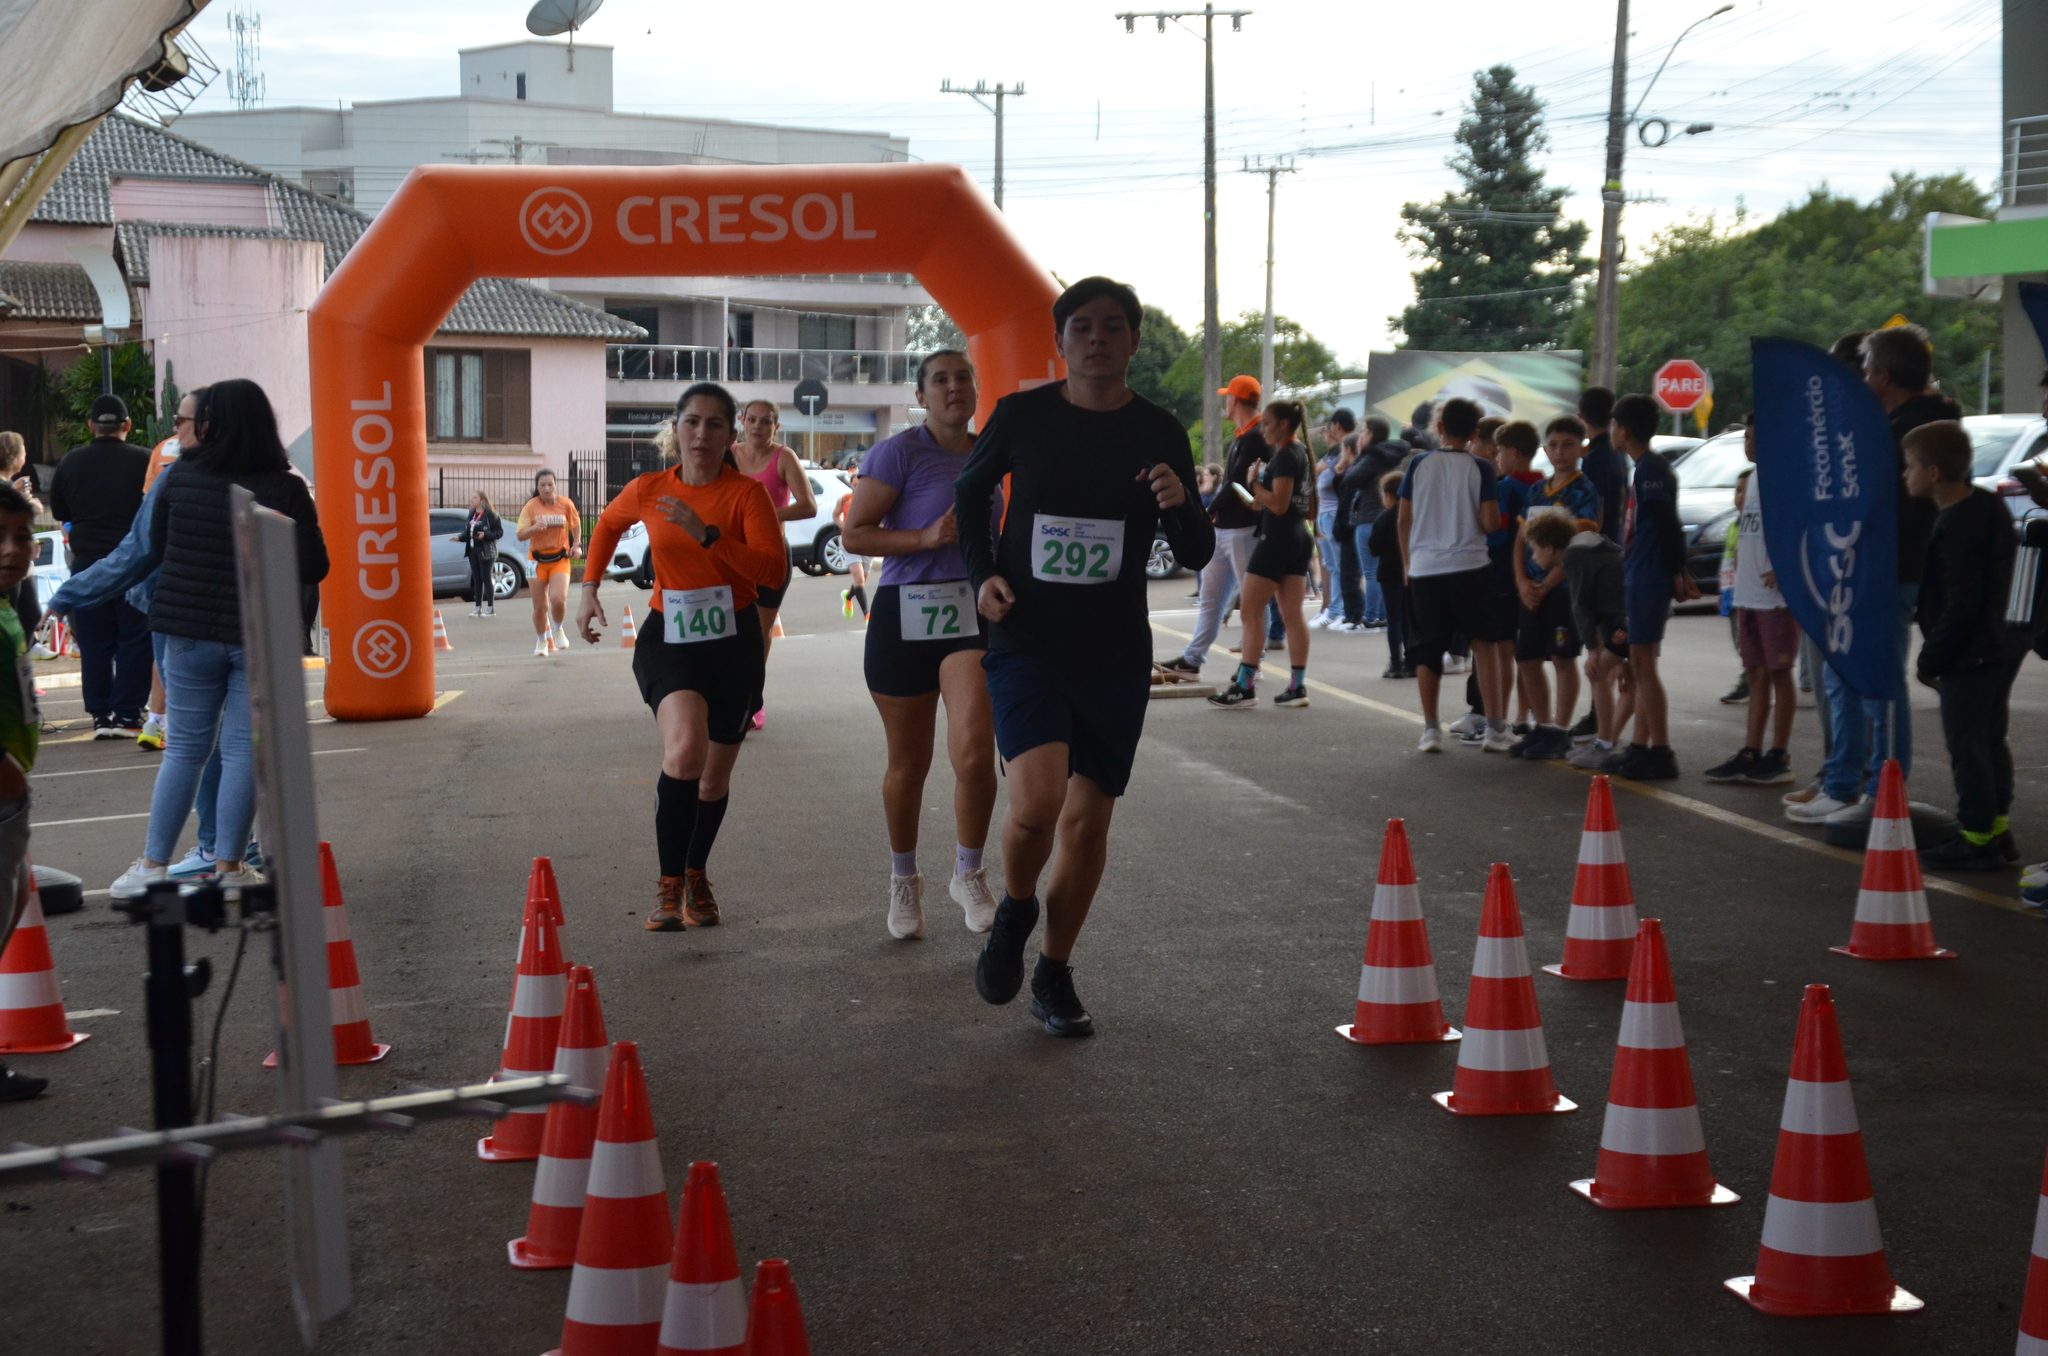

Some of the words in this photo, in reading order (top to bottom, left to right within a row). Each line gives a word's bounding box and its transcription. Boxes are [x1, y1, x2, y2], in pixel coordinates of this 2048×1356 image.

[616, 192, 877, 244] CRESOL
[1659, 377, 1702, 392] PARE
[1806, 376, 1833, 500] Fecomércio
[350, 389, 400, 600] CRESOL
[1041, 525, 1071, 537] Sesc
[1041, 540, 1110, 577] 292
[1825, 521, 1862, 653] Sesc
[673, 606, 726, 638] 140
[921, 604, 960, 635] 72
